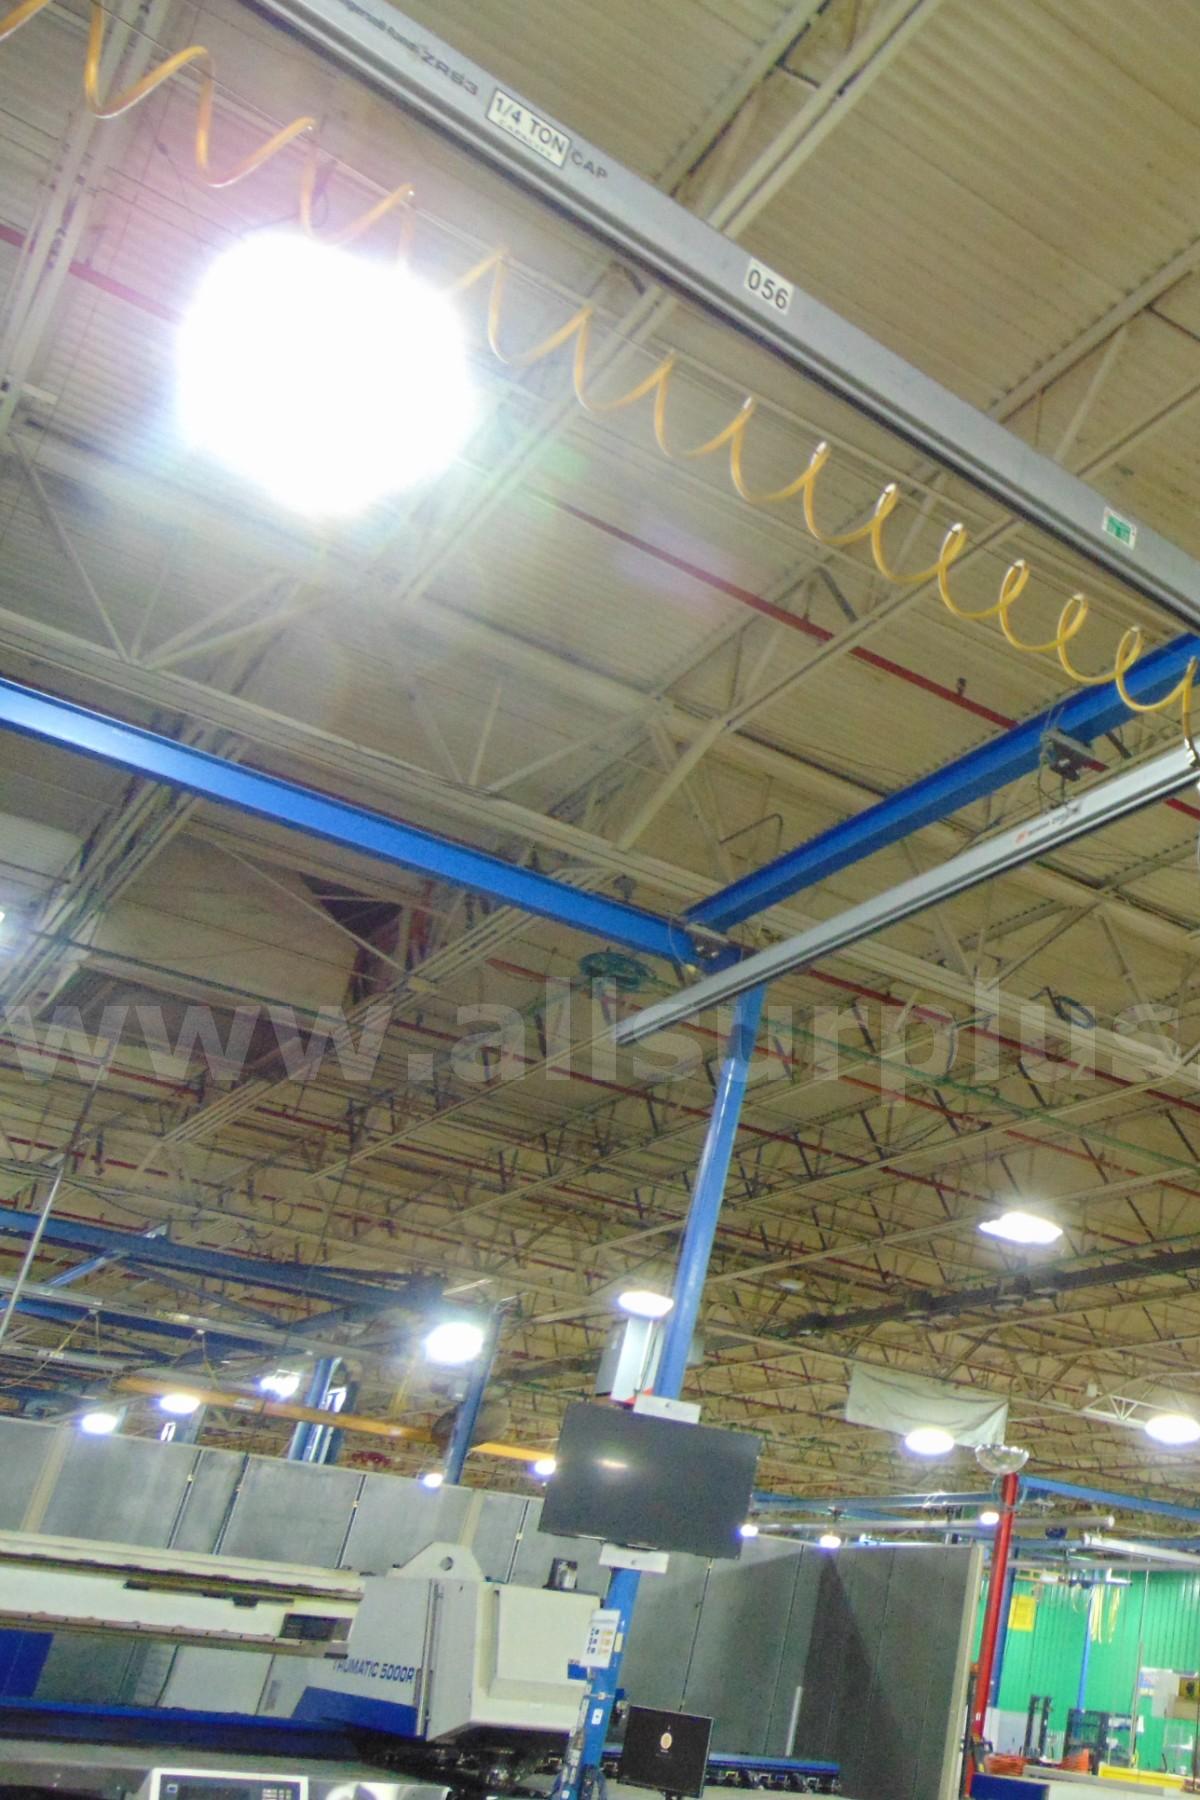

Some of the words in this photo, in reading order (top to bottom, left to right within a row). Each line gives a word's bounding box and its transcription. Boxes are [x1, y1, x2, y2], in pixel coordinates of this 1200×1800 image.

[496, 97, 522, 123] 1/4
[530, 117, 565, 154] TON
[571, 150, 608, 179] CAP
[748, 269, 788, 310] 056
